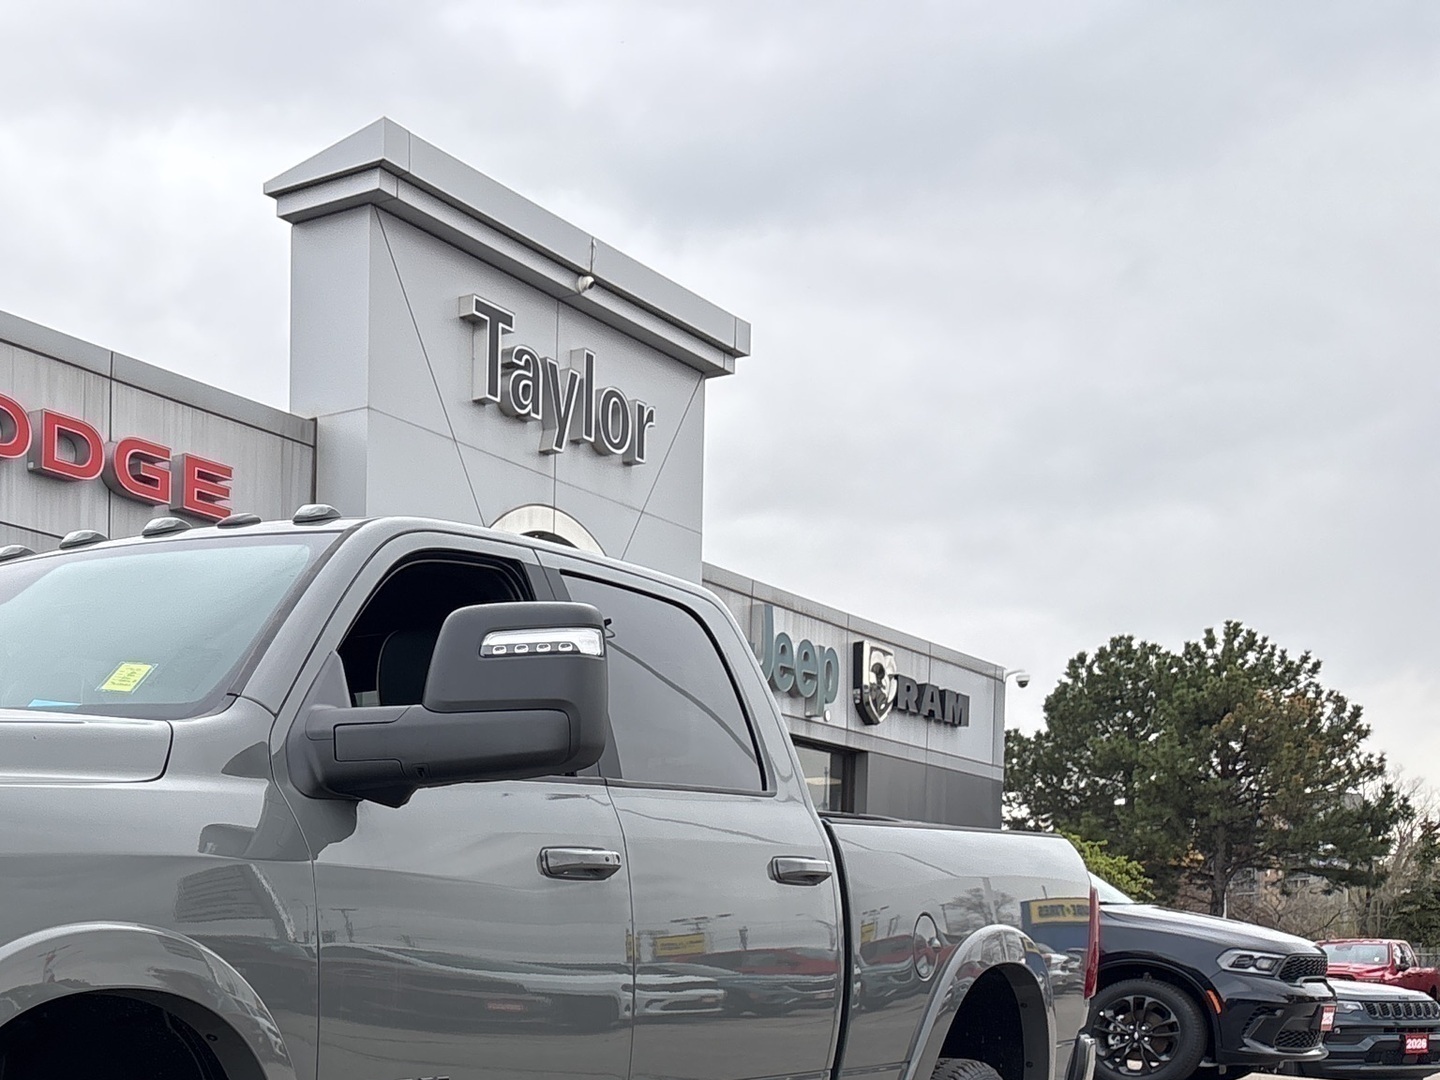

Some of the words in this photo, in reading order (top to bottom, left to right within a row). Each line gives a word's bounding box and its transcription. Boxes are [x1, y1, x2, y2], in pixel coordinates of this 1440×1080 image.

[468, 293, 656, 463] Taylor
[758, 603, 840, 718] Jeep
[894, 673, 970, 727] RAM
